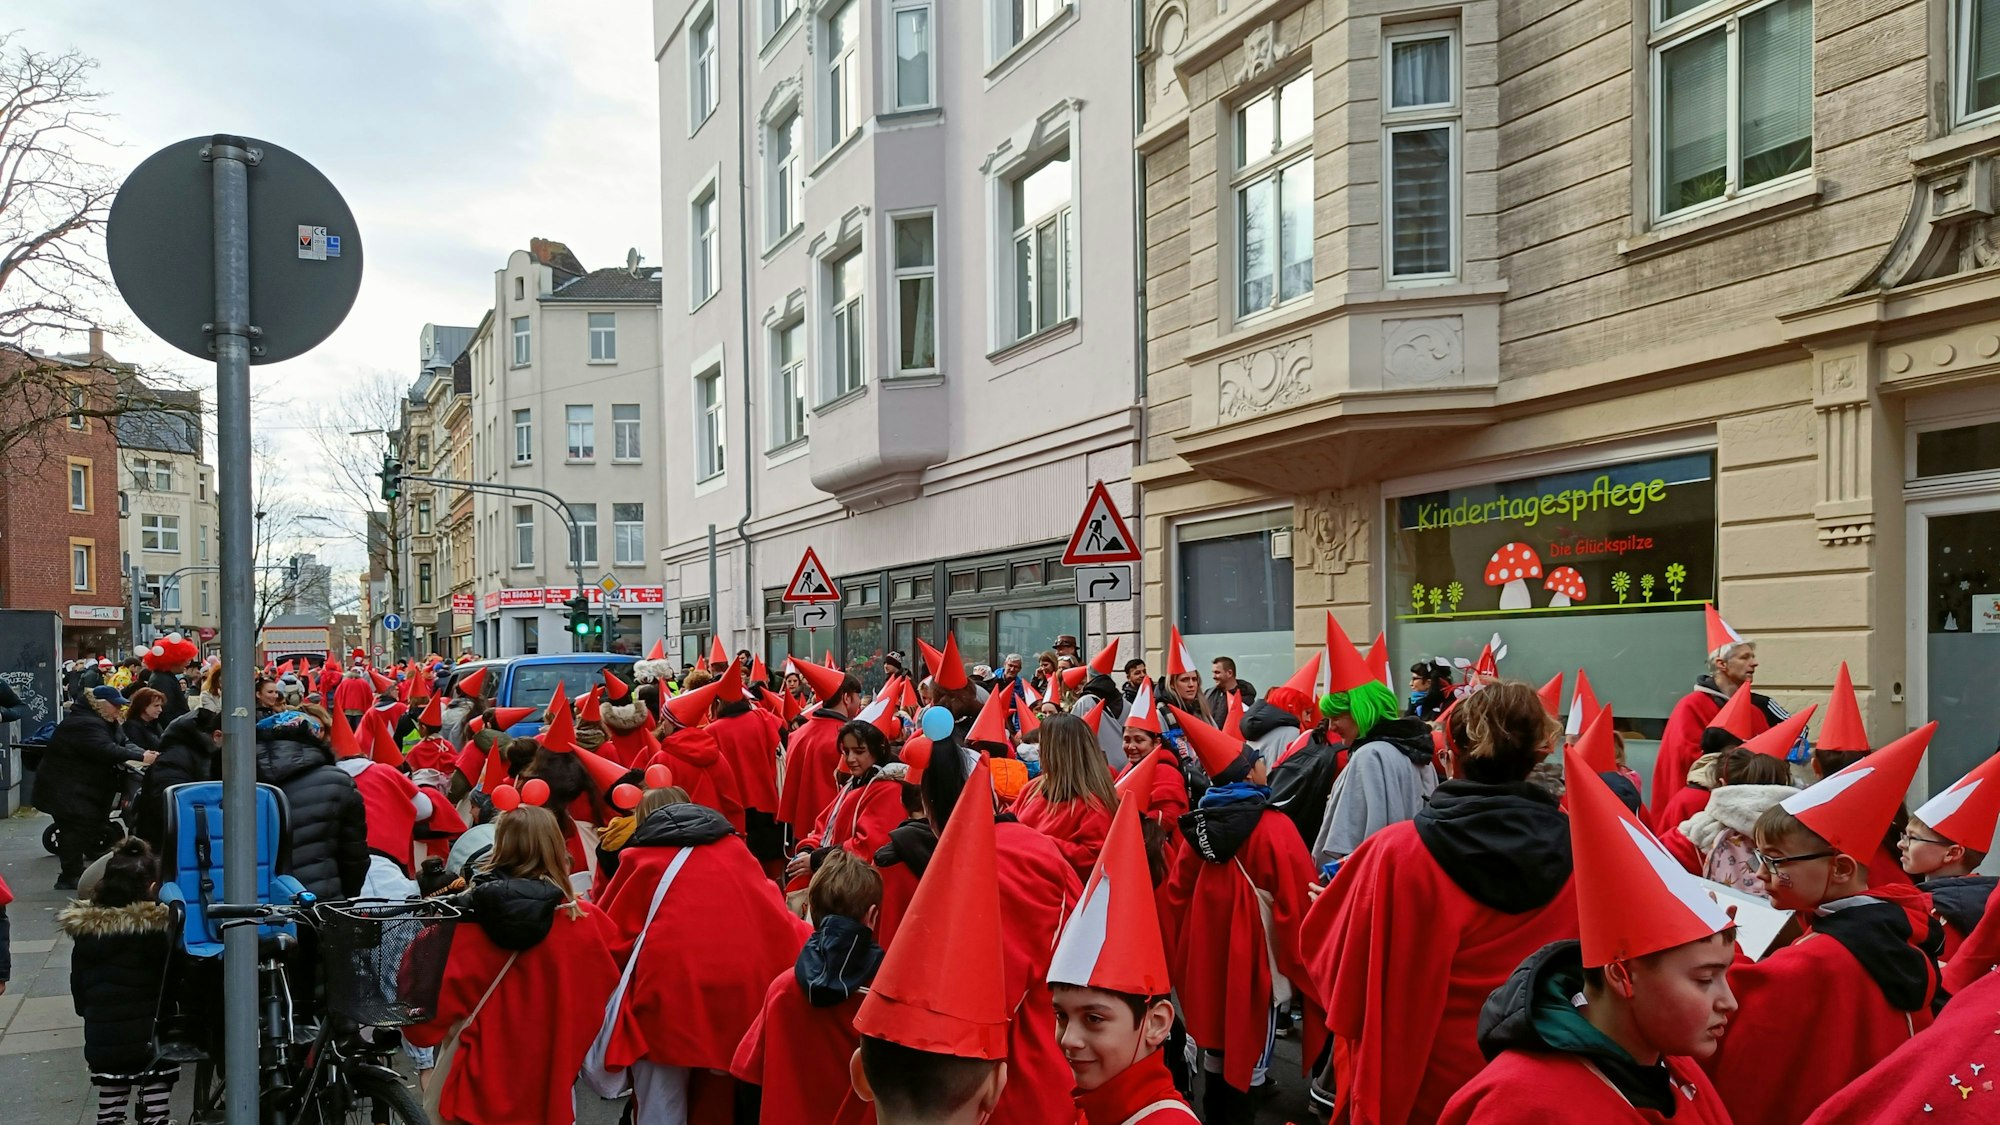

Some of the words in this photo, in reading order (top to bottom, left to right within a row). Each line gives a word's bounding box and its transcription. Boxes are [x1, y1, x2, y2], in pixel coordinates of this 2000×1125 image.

[1418, 475, 1667, 532] Kindertagespflege
[1550, 542, 1572, 557] Die
[1575, 534, 1653, 555] Glückspilze
